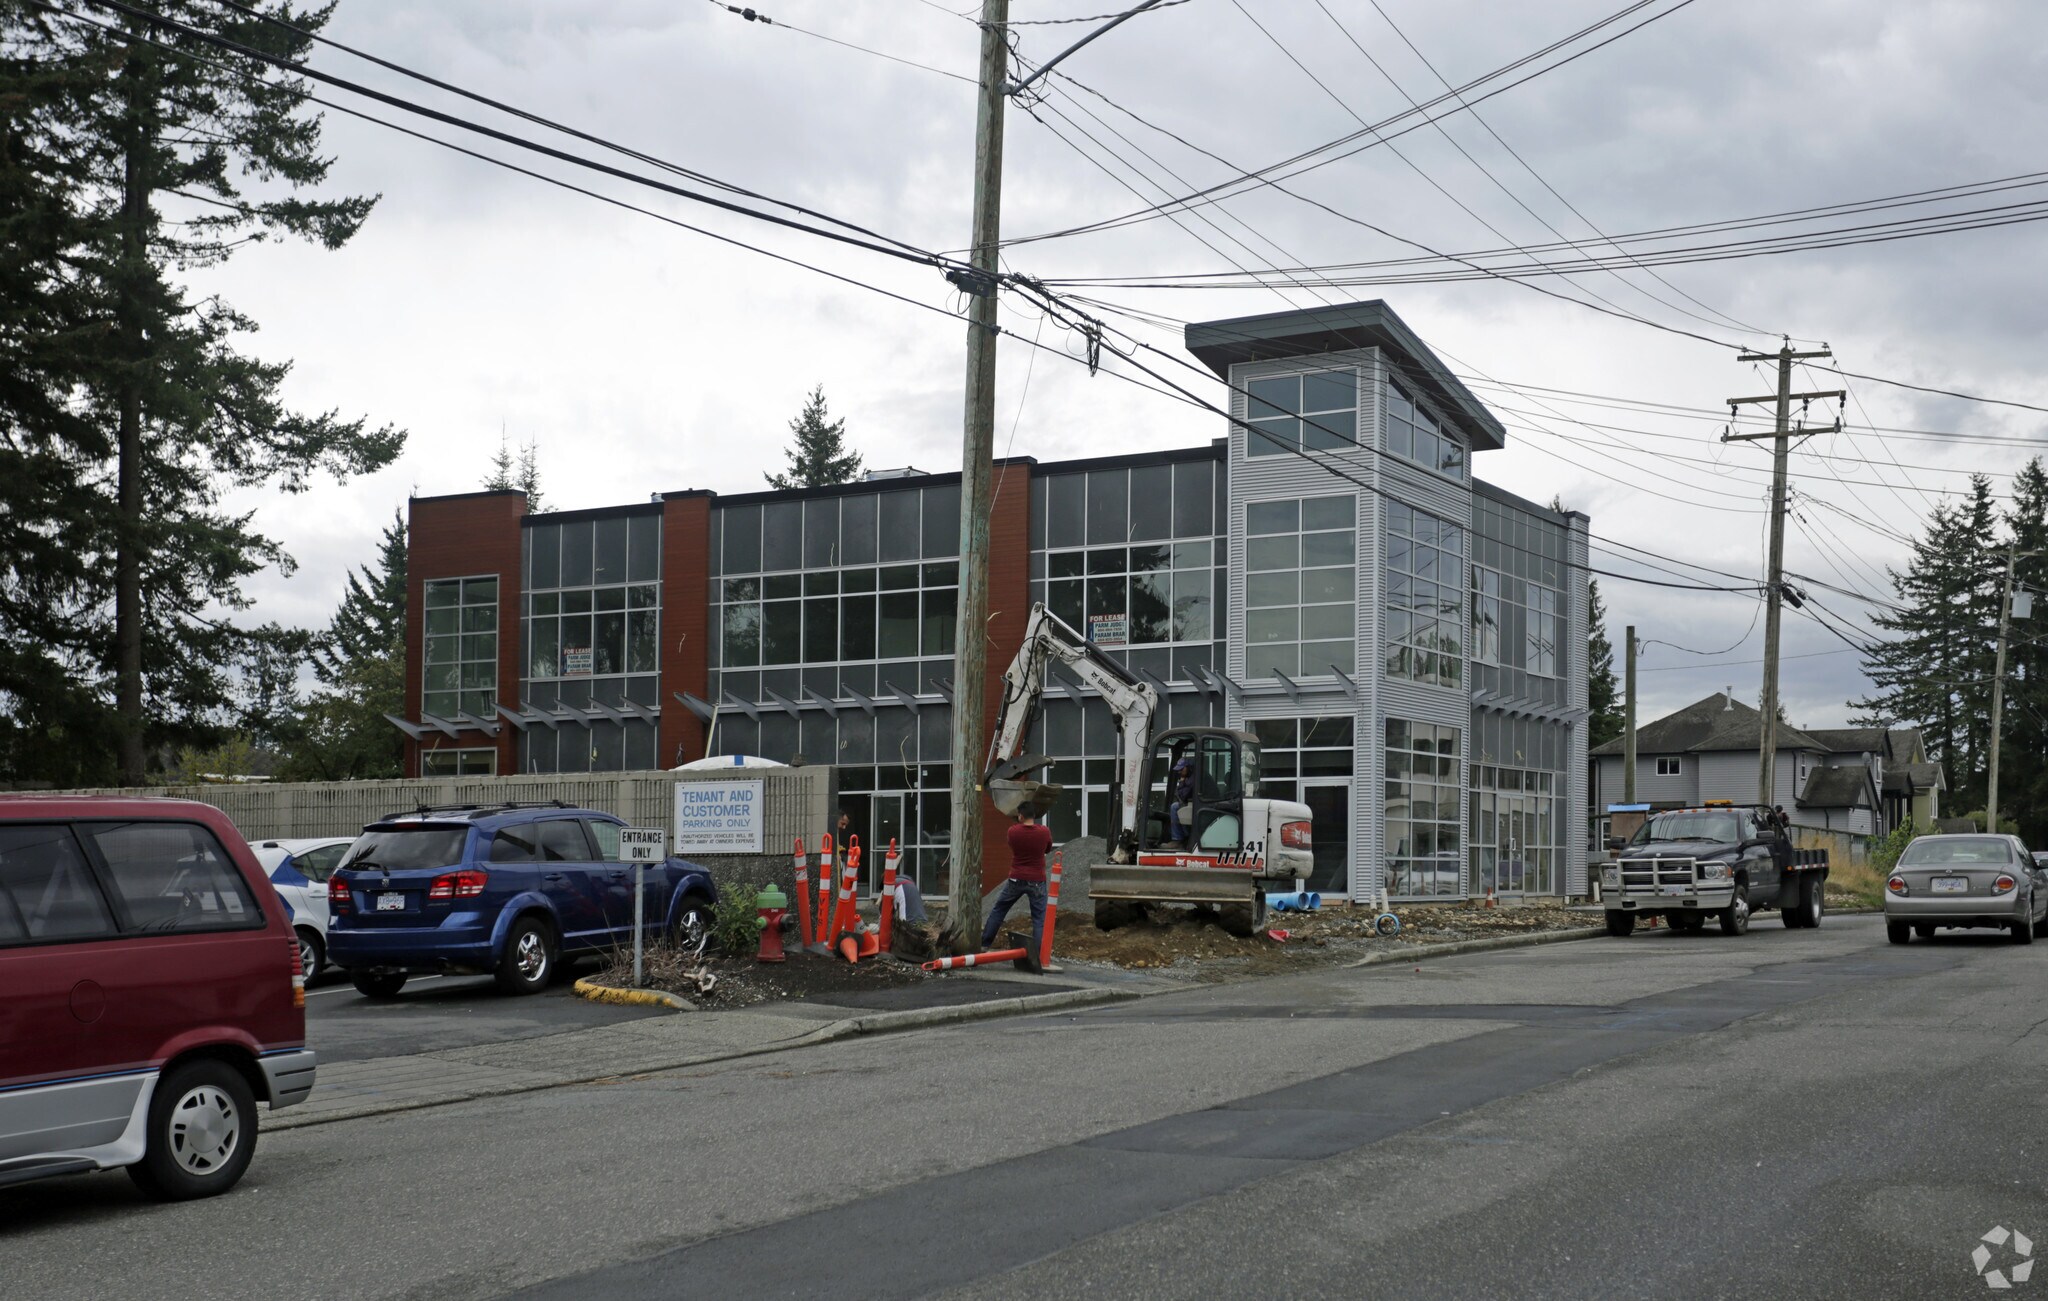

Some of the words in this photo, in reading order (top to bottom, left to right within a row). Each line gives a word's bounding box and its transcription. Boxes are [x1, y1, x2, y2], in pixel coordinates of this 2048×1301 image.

[1097, 677, 1117, 695] Bobcat
[682, 790, 725, 803] TENANT
[729, 790, 754, 802] AND
[682, 804, 750, 817] CUSTOMER
[682, 819, 722, 828] PARKING
[726, 818, 751, 827] ONLY
[622, 831, 662, 844] ENTRANCE
[632, 847, 651, 858] ONLY
[1187, 860, 1210, 868] Bobcat
